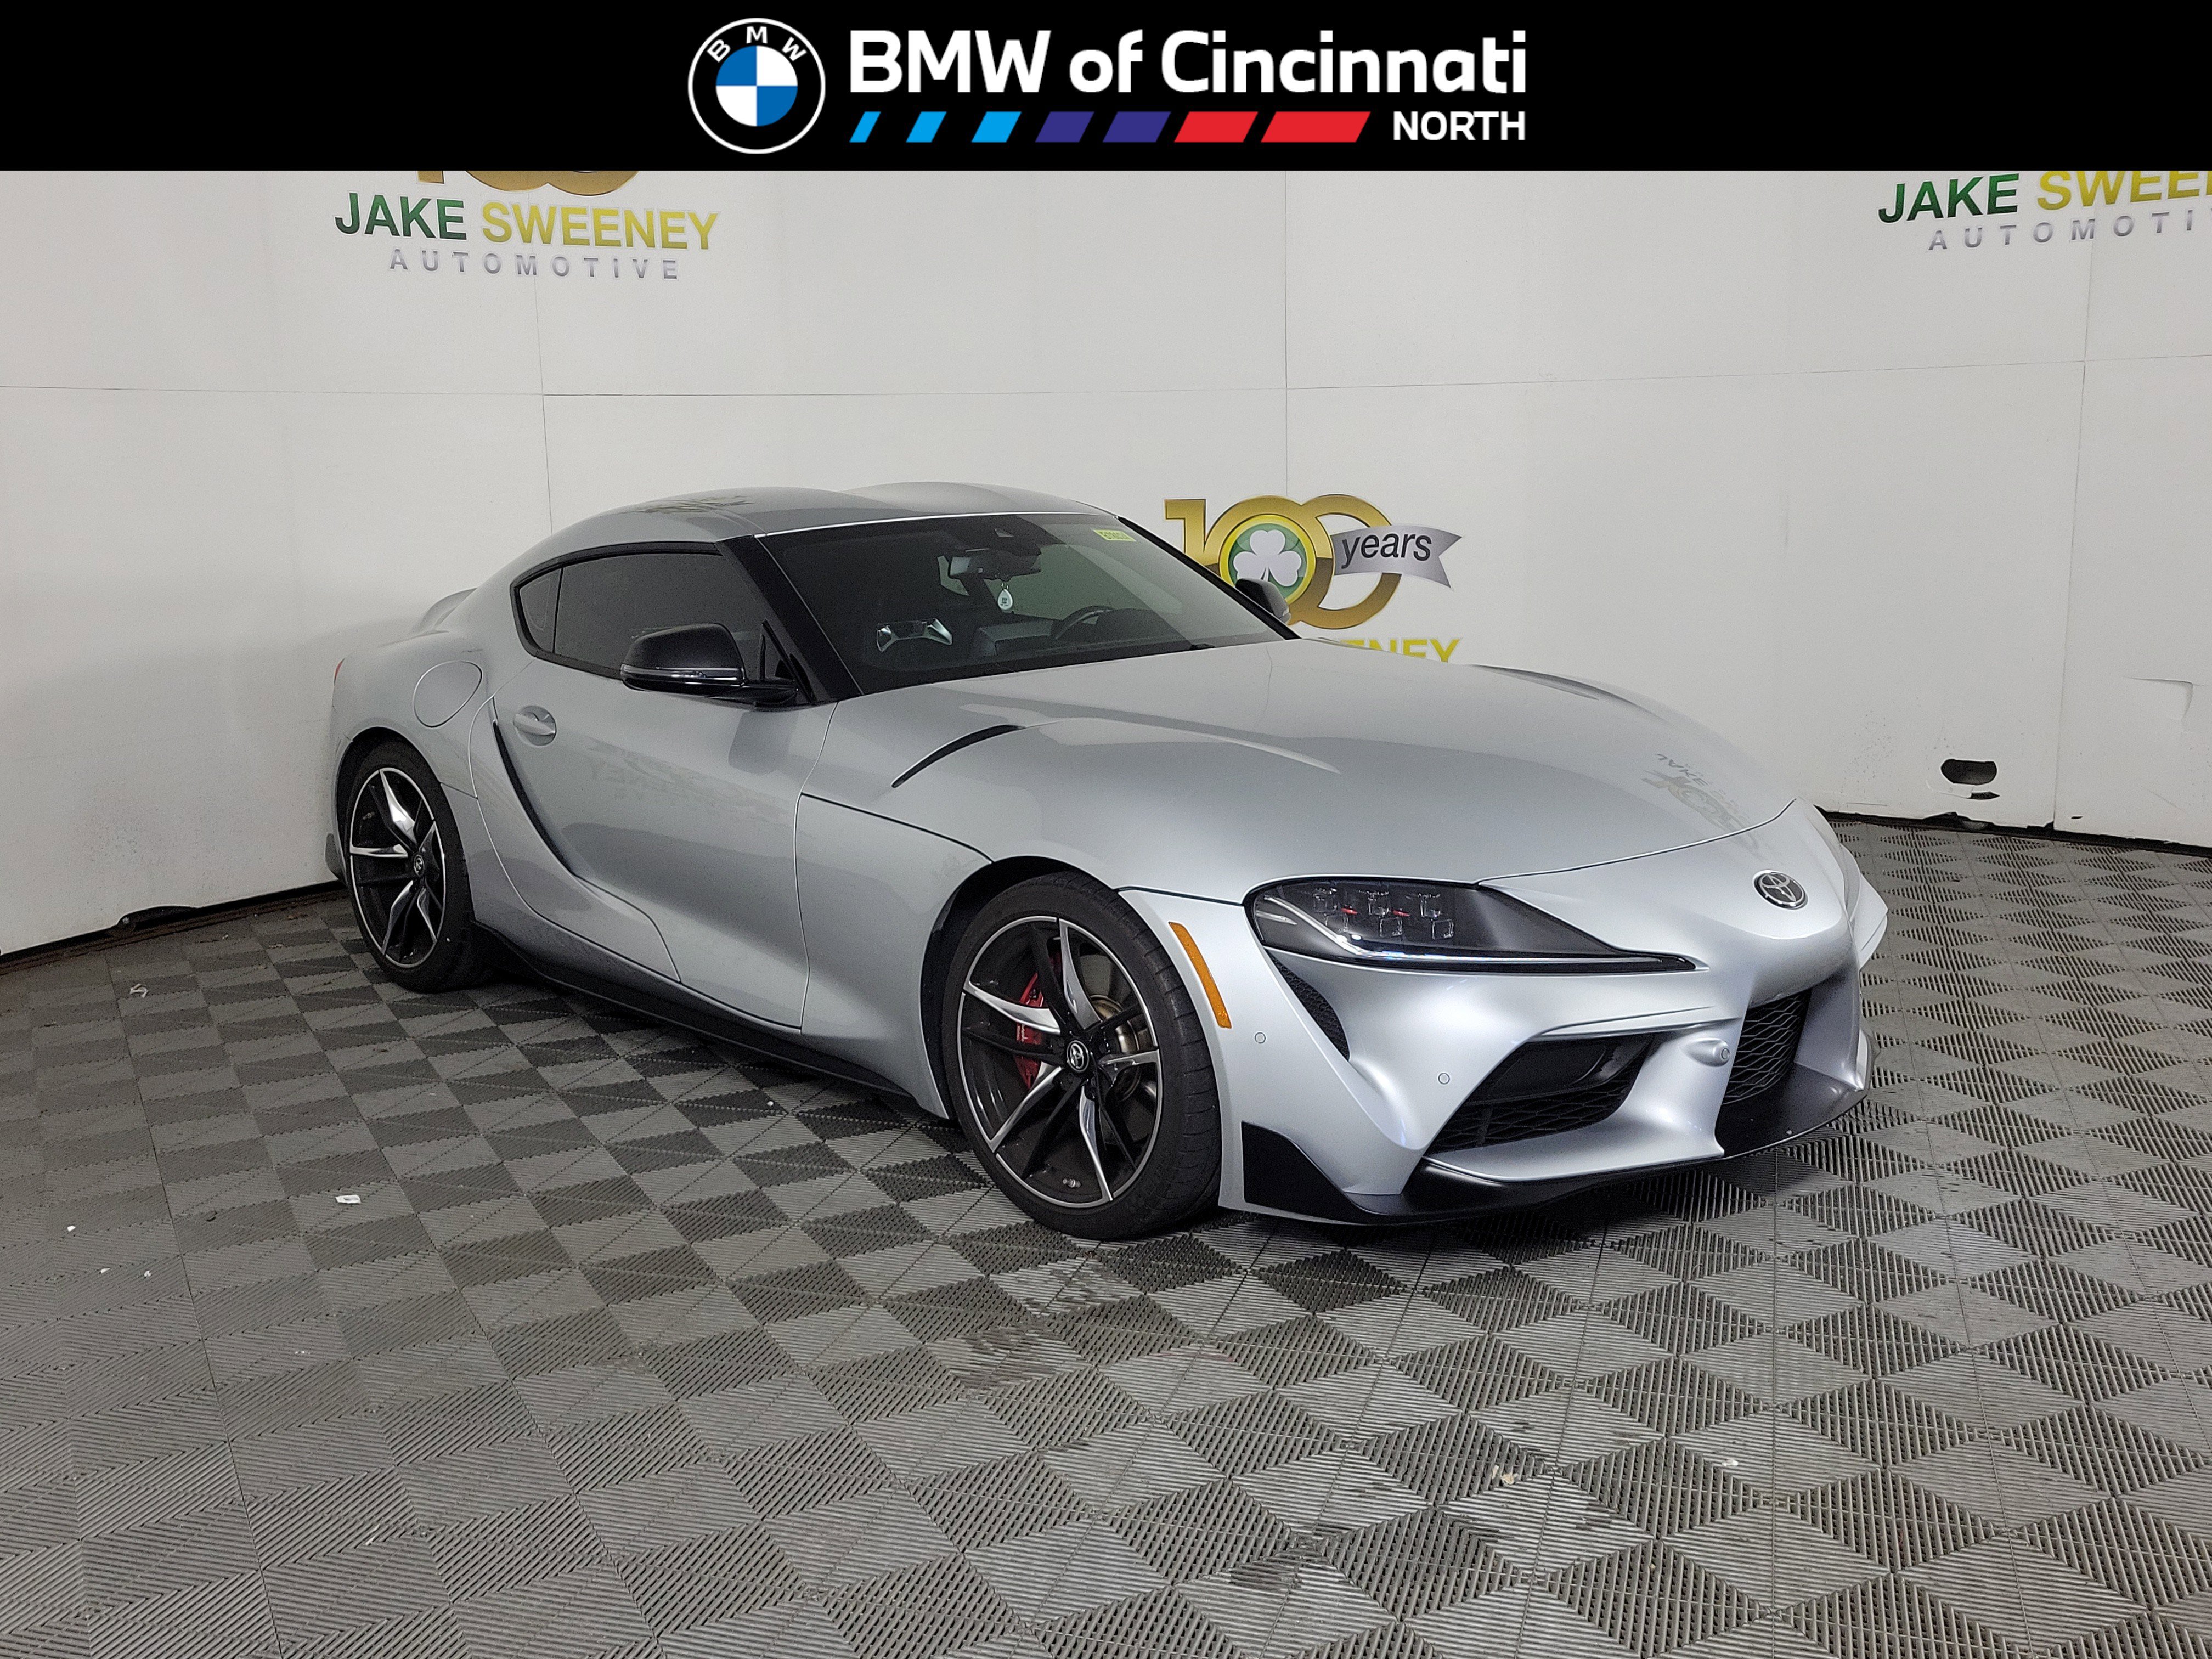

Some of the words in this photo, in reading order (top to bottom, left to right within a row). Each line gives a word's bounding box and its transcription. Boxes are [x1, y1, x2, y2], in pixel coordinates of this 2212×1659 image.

[1878, 173, 2020, 224] JAKE
[334, 192, 467, 241] JAKE
[482, 201, 719, 250] SWEENEY
[390, 249, 679, 280] AUTOMOTIVE
[1341, 533, 1432, 569] years
